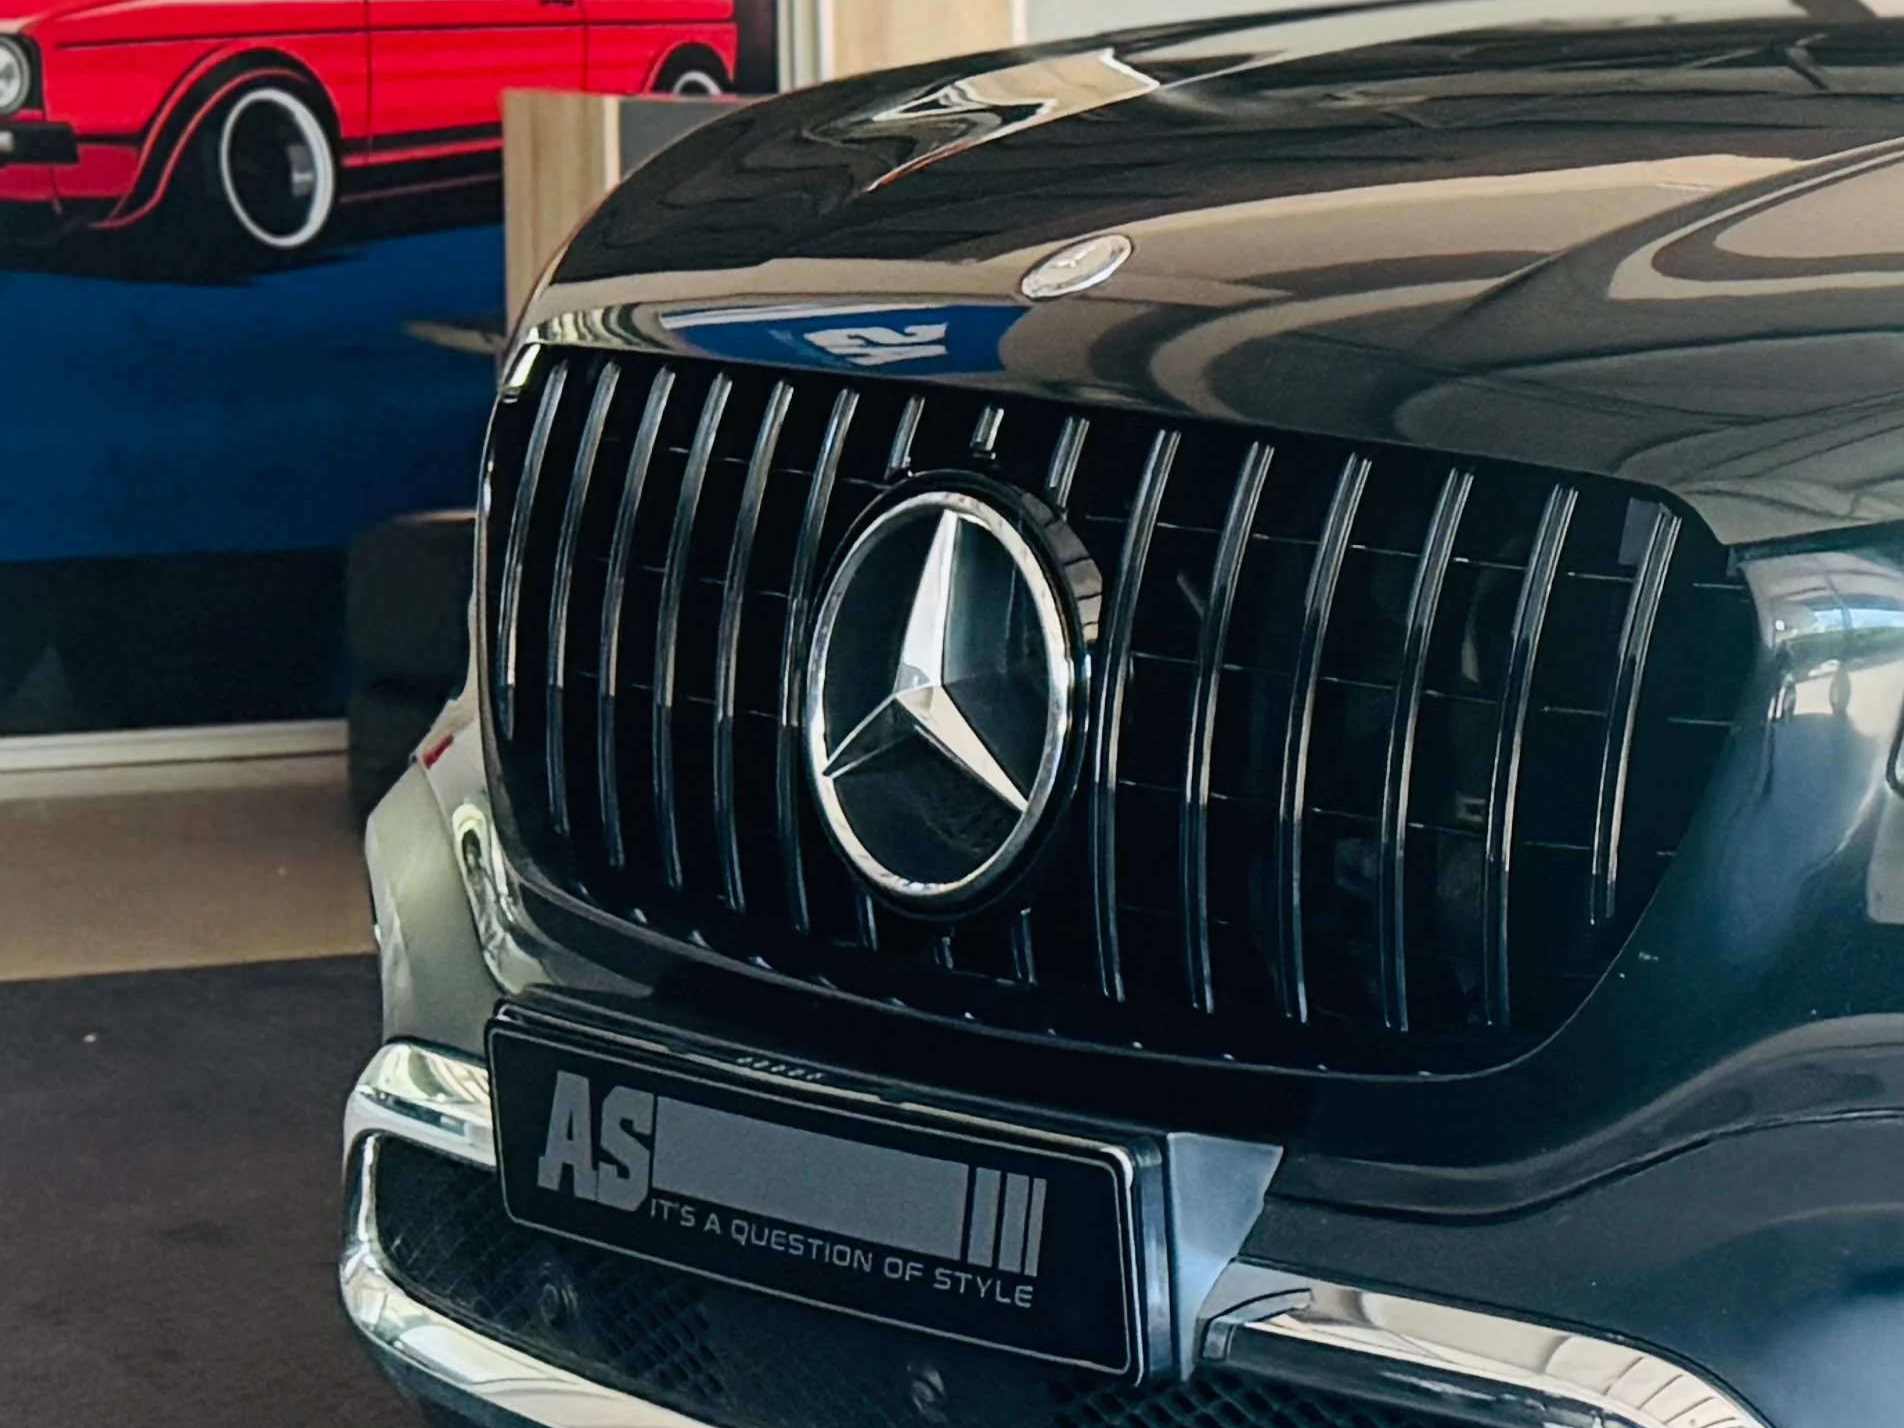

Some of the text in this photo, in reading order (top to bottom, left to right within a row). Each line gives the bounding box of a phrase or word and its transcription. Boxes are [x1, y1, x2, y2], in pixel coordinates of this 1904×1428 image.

[537, 1069, 656, 1212] AS
[650, 1198, 1035, 1308] IT'S A QUESTION OF STYLE
